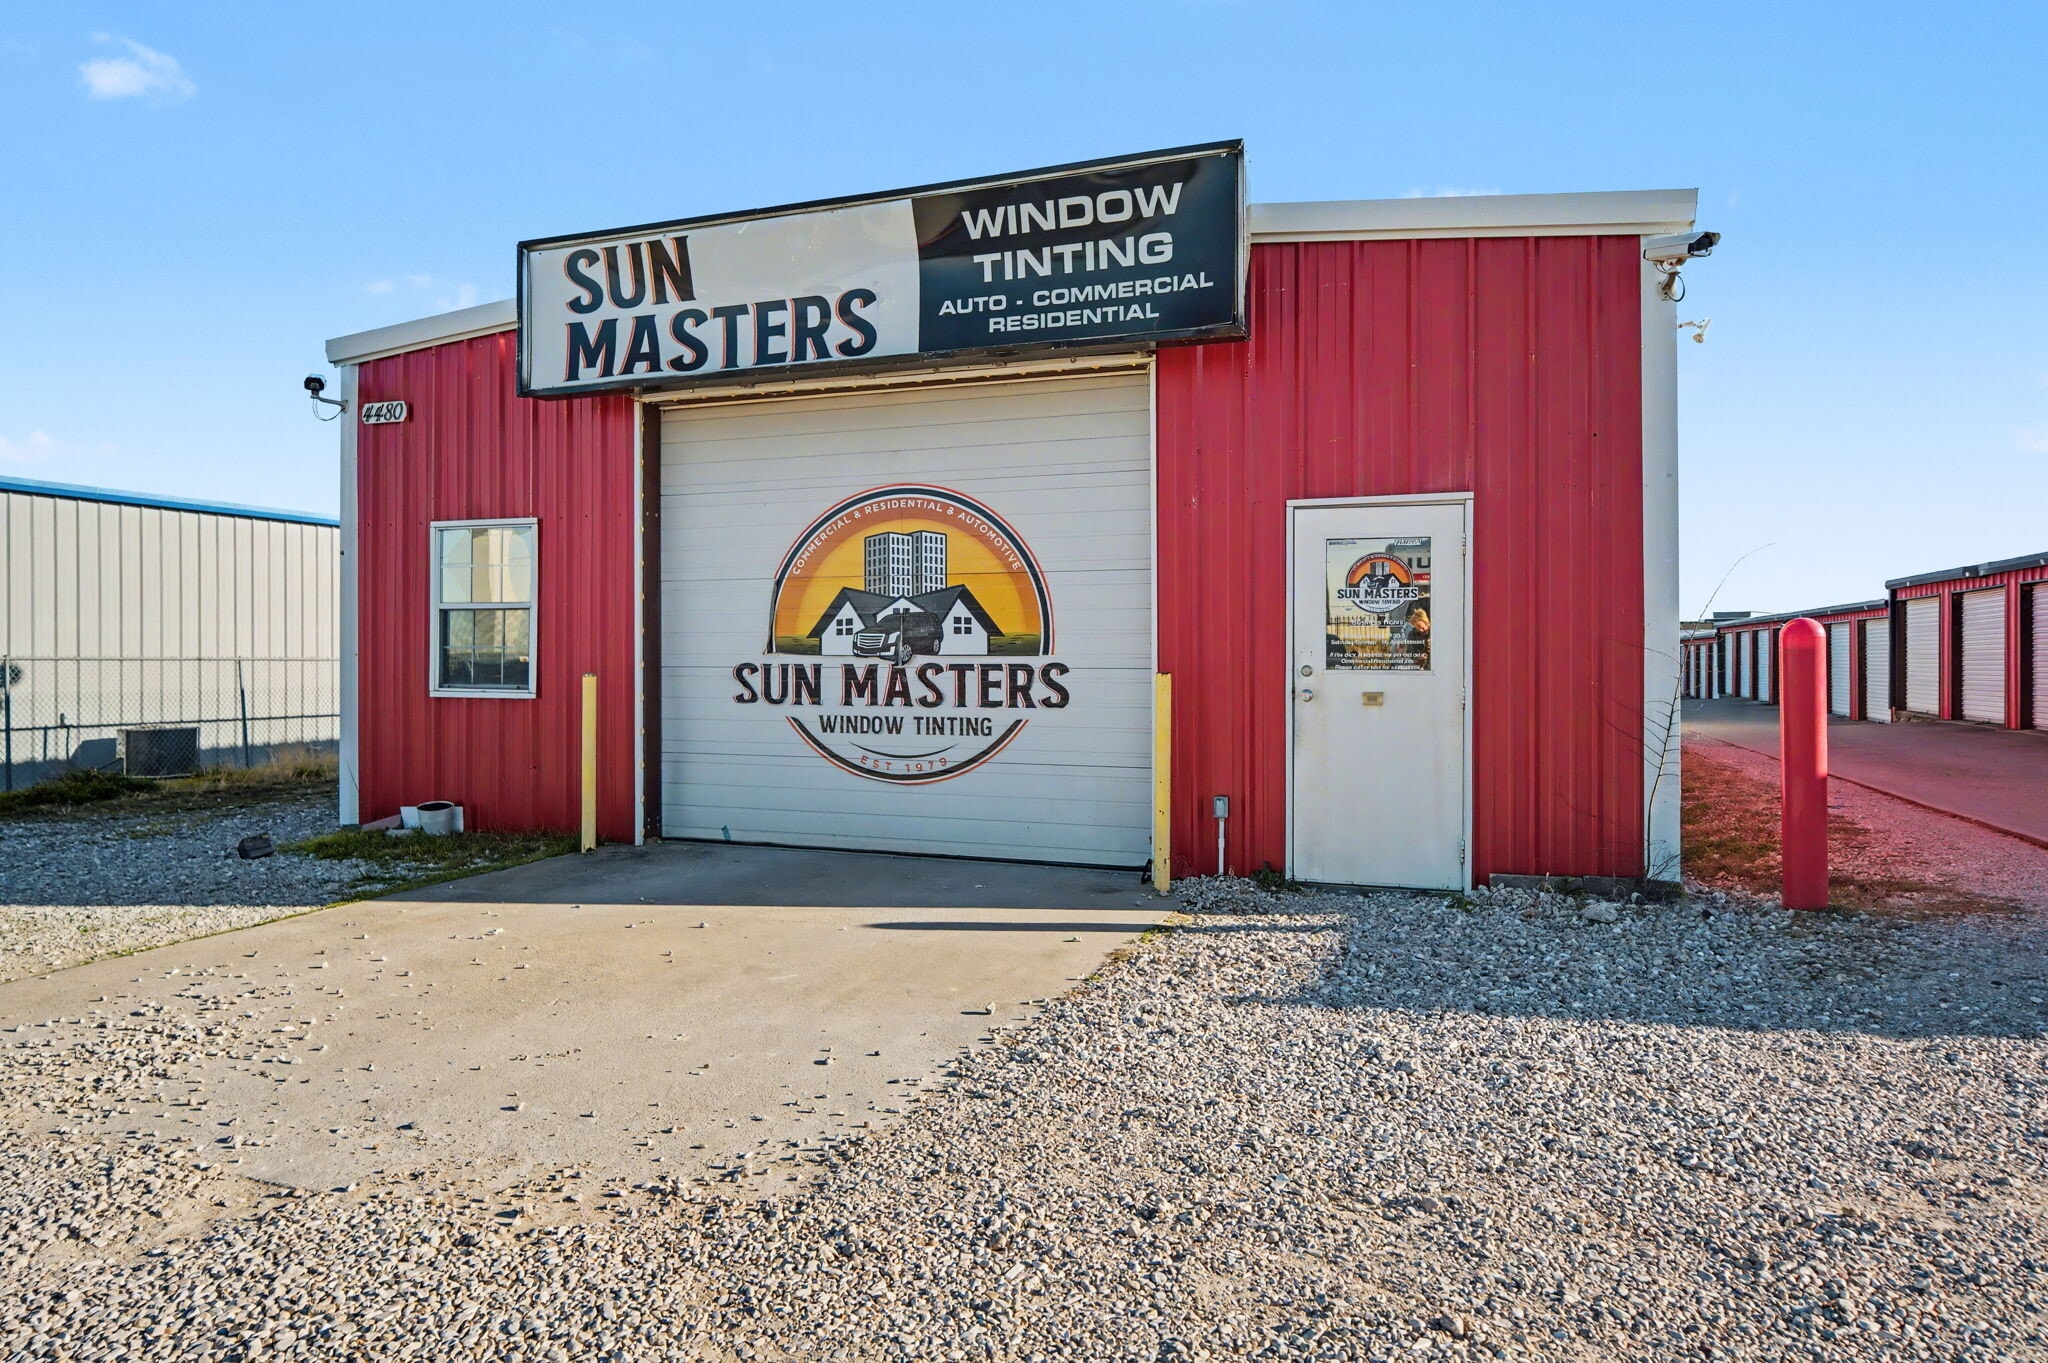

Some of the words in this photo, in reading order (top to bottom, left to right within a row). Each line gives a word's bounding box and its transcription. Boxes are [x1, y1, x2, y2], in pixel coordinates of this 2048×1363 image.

[961, 182, 1183, 240] WINDOW
[564, 235, 696, 314] SUN
[973, 232, 1174, 283] TINTING
[938, 295, 1007, 316] AUTO
[1033, 272, 1213, 307] COMMERCIAL
[563, 288, 877, 382] MASTERS
[988, 302, 1159, 333] RESIDENTIAL
[363, 402, 403, 422] 4480
[793, 516, 851, 576] COMMERCIAL
[854, 510, 861, 519] &
[864, 499, 943, 515] RESIDENTIAL
[946, 506, 954, 515] &
[958, 511, 1021, 572] AUTOMOTIVE
[1337, 588, 1360, 599] SUN
[1364, 588, 1418, 599] MASTERS
[732, 663, 822, 706] SUN
[840, 662, 1070, 709] MASTERS
[819, 714, 904, 735] WINDOW
[913, 716, 993, 737] TINTING
[860, 755, 891, 772] EST
[905, 757, 948, 773] 1979
